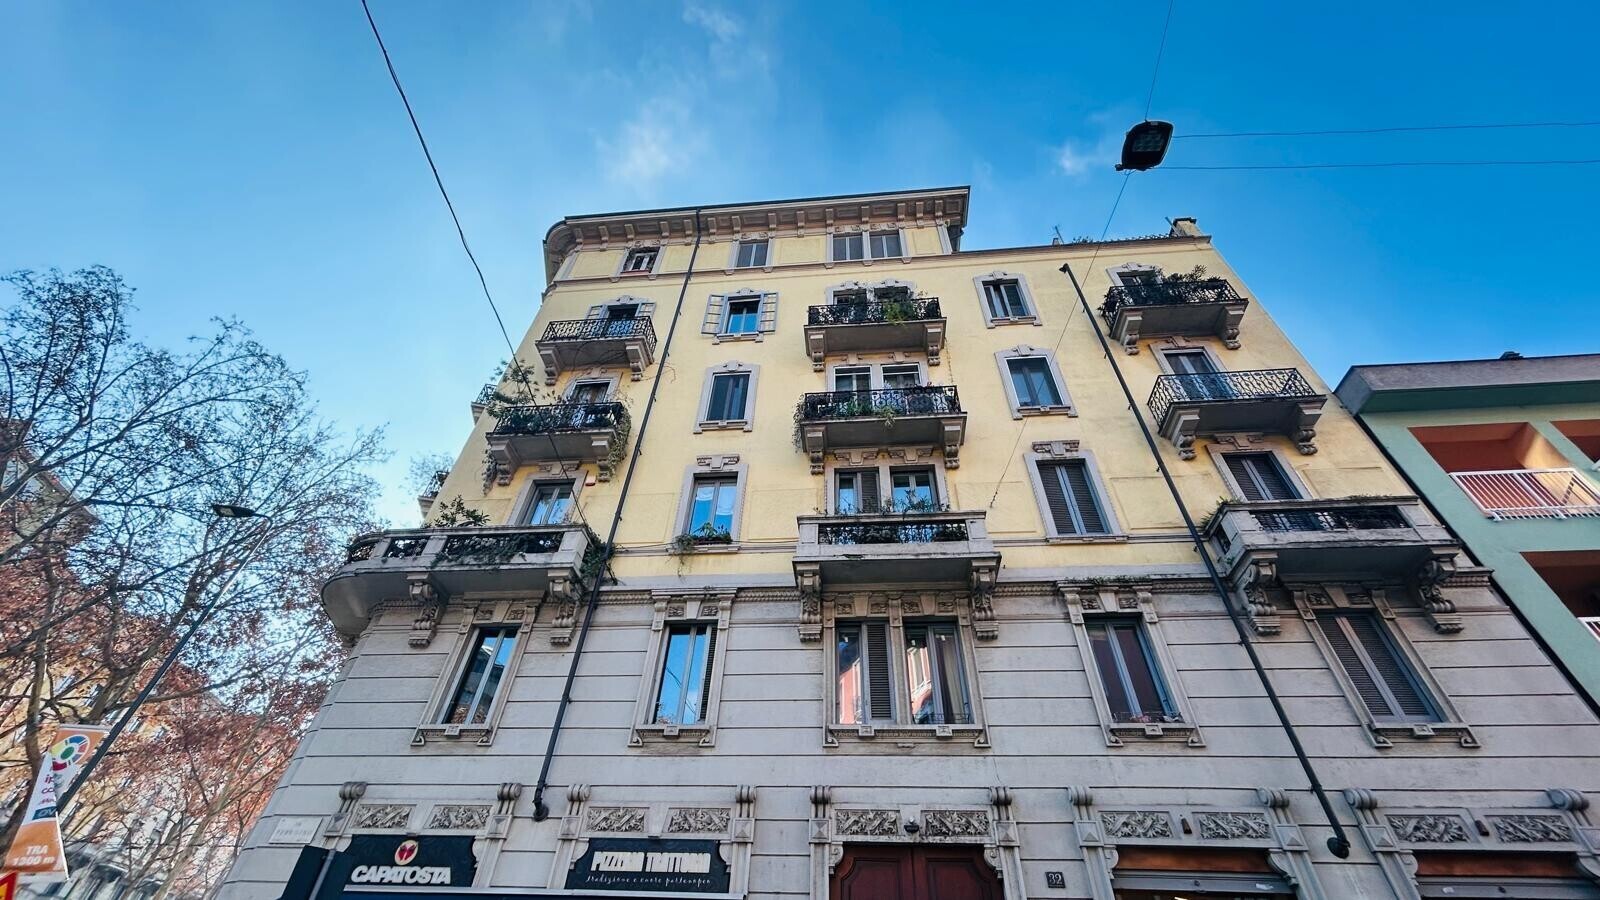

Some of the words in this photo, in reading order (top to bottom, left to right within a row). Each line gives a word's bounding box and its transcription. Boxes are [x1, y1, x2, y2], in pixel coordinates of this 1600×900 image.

[26, 845, 48, 855] TRA
[351, 865, 451, 884] CAPATOSTA
[1048, 873, 1063, 885] 32
